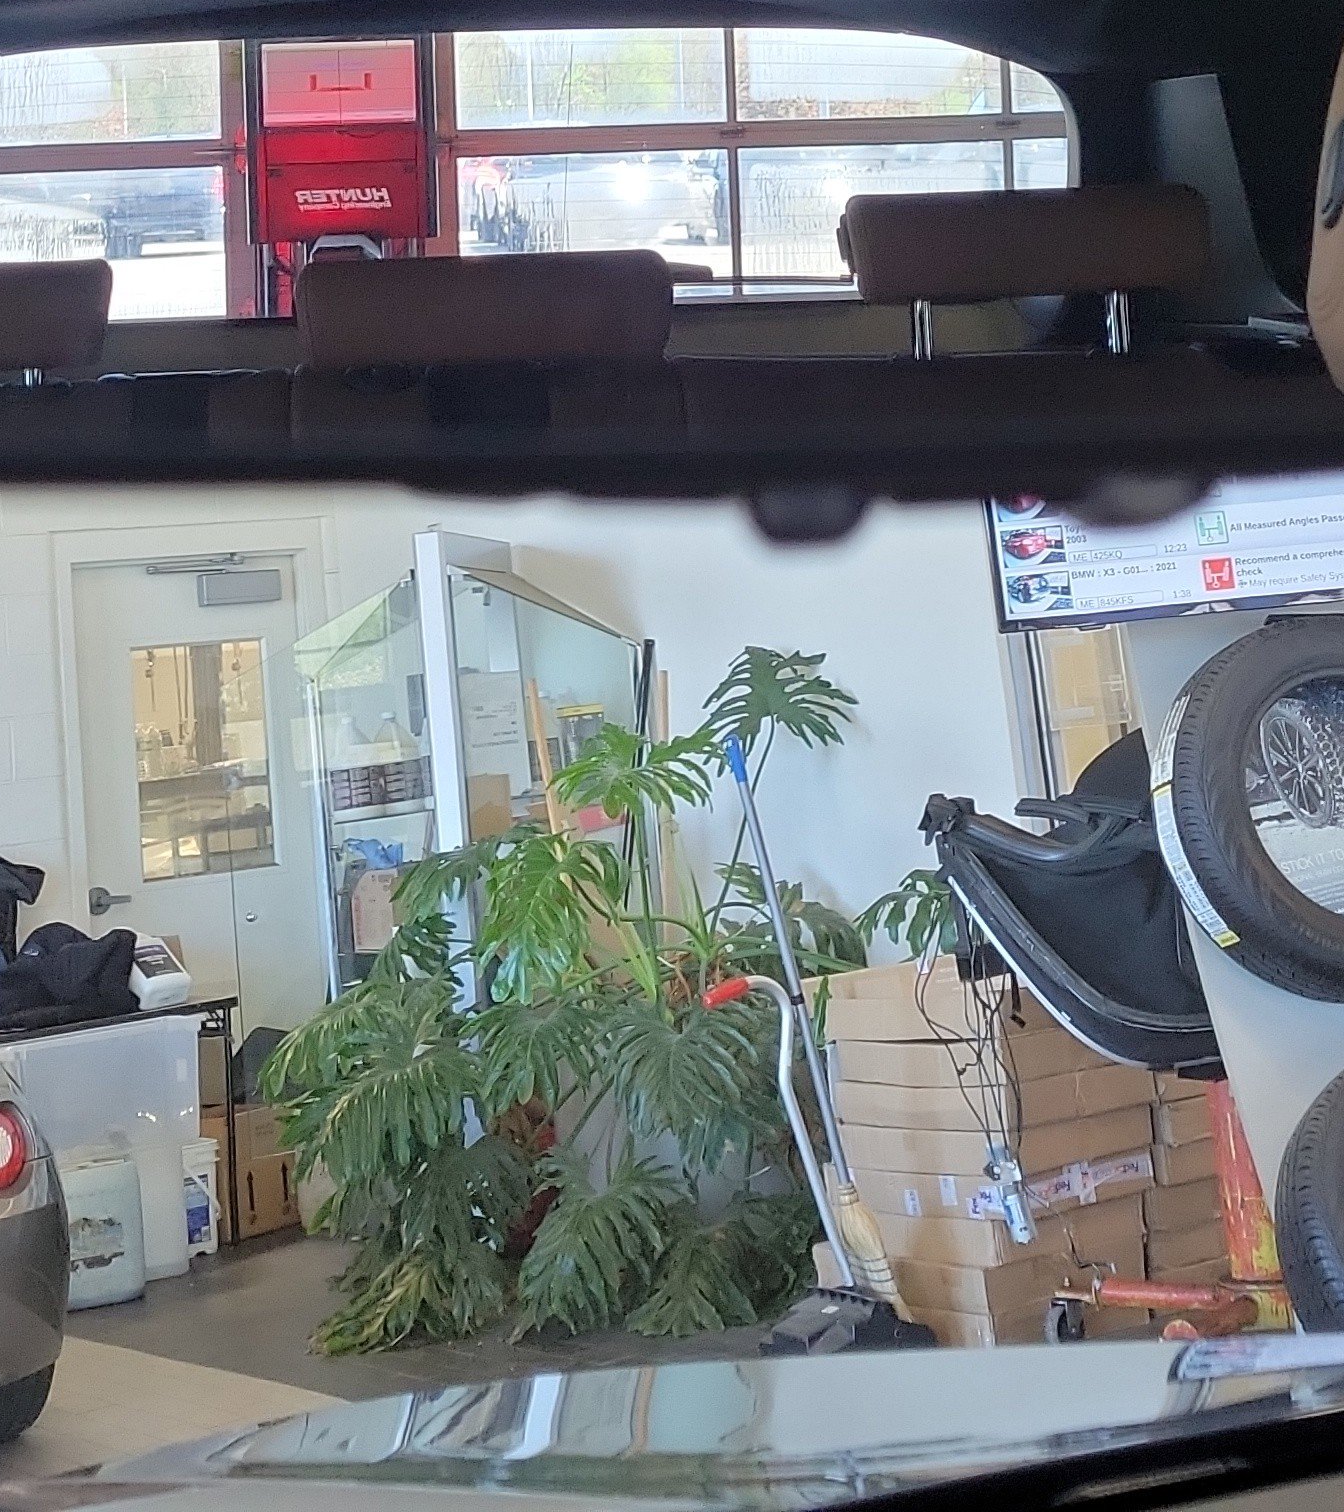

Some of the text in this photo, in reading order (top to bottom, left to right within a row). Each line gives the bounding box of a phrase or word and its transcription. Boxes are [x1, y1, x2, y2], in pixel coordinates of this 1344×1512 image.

[1230, 523, 1242, 532] All
[1244, 519, 1287, 531] Measured
[1289, 516, 1319, 529] Angles
[1066, 535, 1087, 544] 2003
[1073, 552, 1087, 561] ME
[1164, 544, 1187, 553] 12:23
[1235, 552, 1290, 566] Recommend
[1071, 569, 1096, 579] BMW
[1103, 568, 1115, 576] X3
[1156, 562, 1177, 571] 2021
[1236, 567, 1262, 577] check
[1249, 579, 1266, 588] May
[1268, 575, 1298, 587] require
[1300, 571, 1326, 583] Safety
[1080, 599, 1094, 609] ME
[1100, 595, 1134, 606] 845KFS
[1173, 590, 1191, 598] 1:38
[1281, 858, 1313, 875] STICK
[1315, 851, 1325, 864] IT
[1330, 848, 1344, 861] TO
